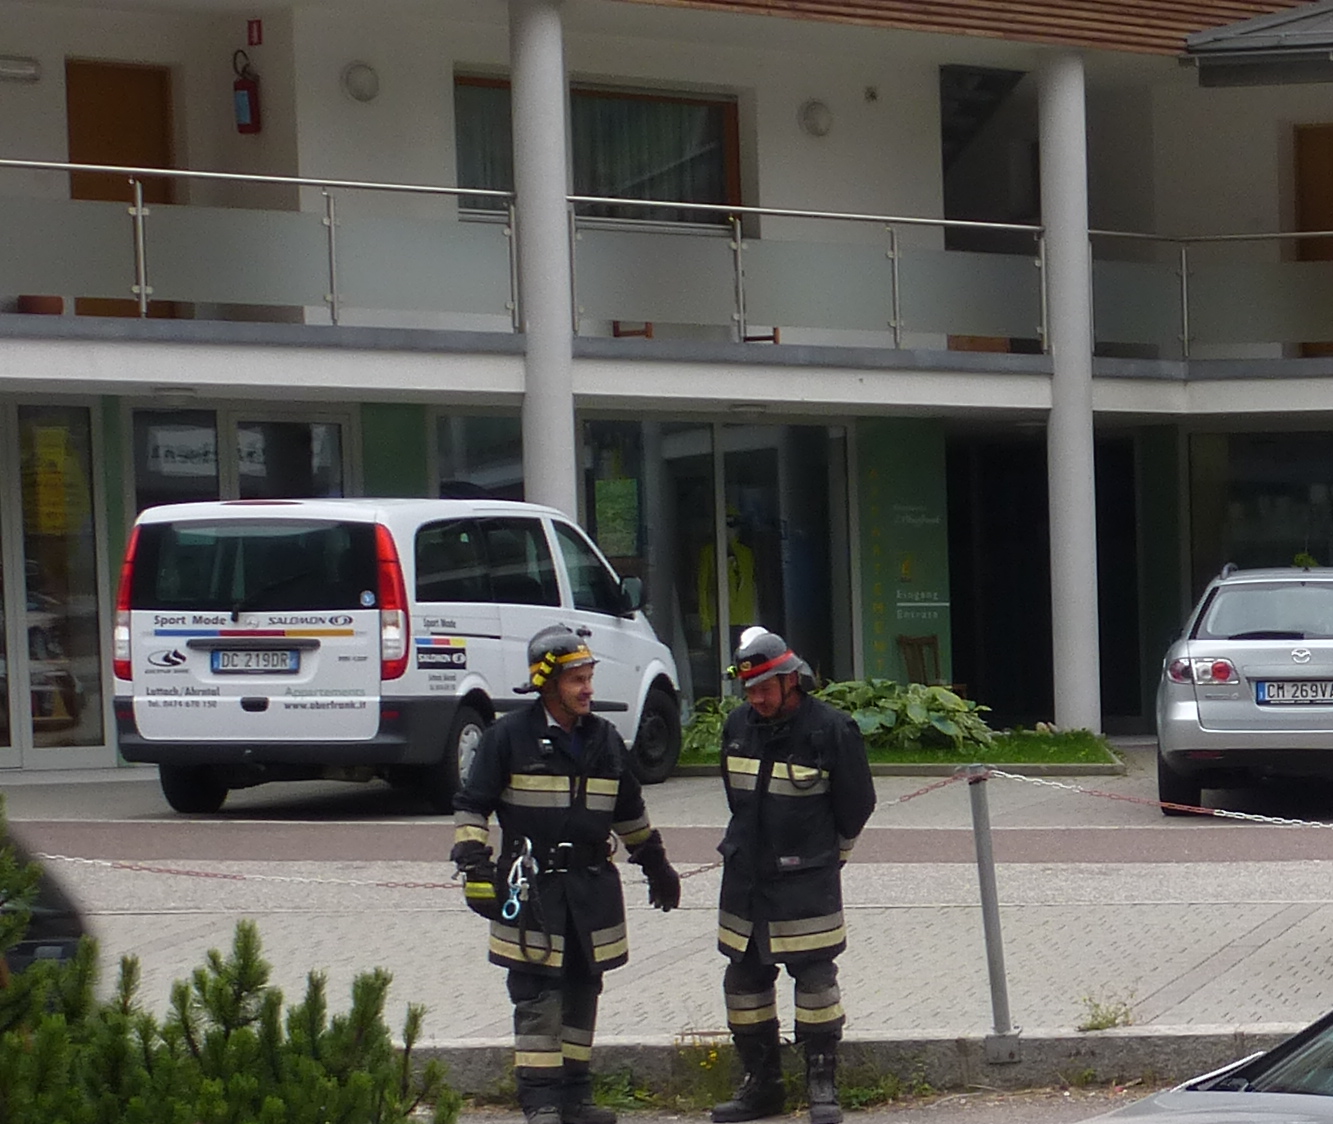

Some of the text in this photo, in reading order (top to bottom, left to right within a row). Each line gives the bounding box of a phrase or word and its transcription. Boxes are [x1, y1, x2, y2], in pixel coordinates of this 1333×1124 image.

[154, 615, 226, 626] Sport Mode
[268, 616, 326, 625] SALOMON
[221, 652, 289, 668] DC 219DR
[1266, 681, 1286, 699] CM
